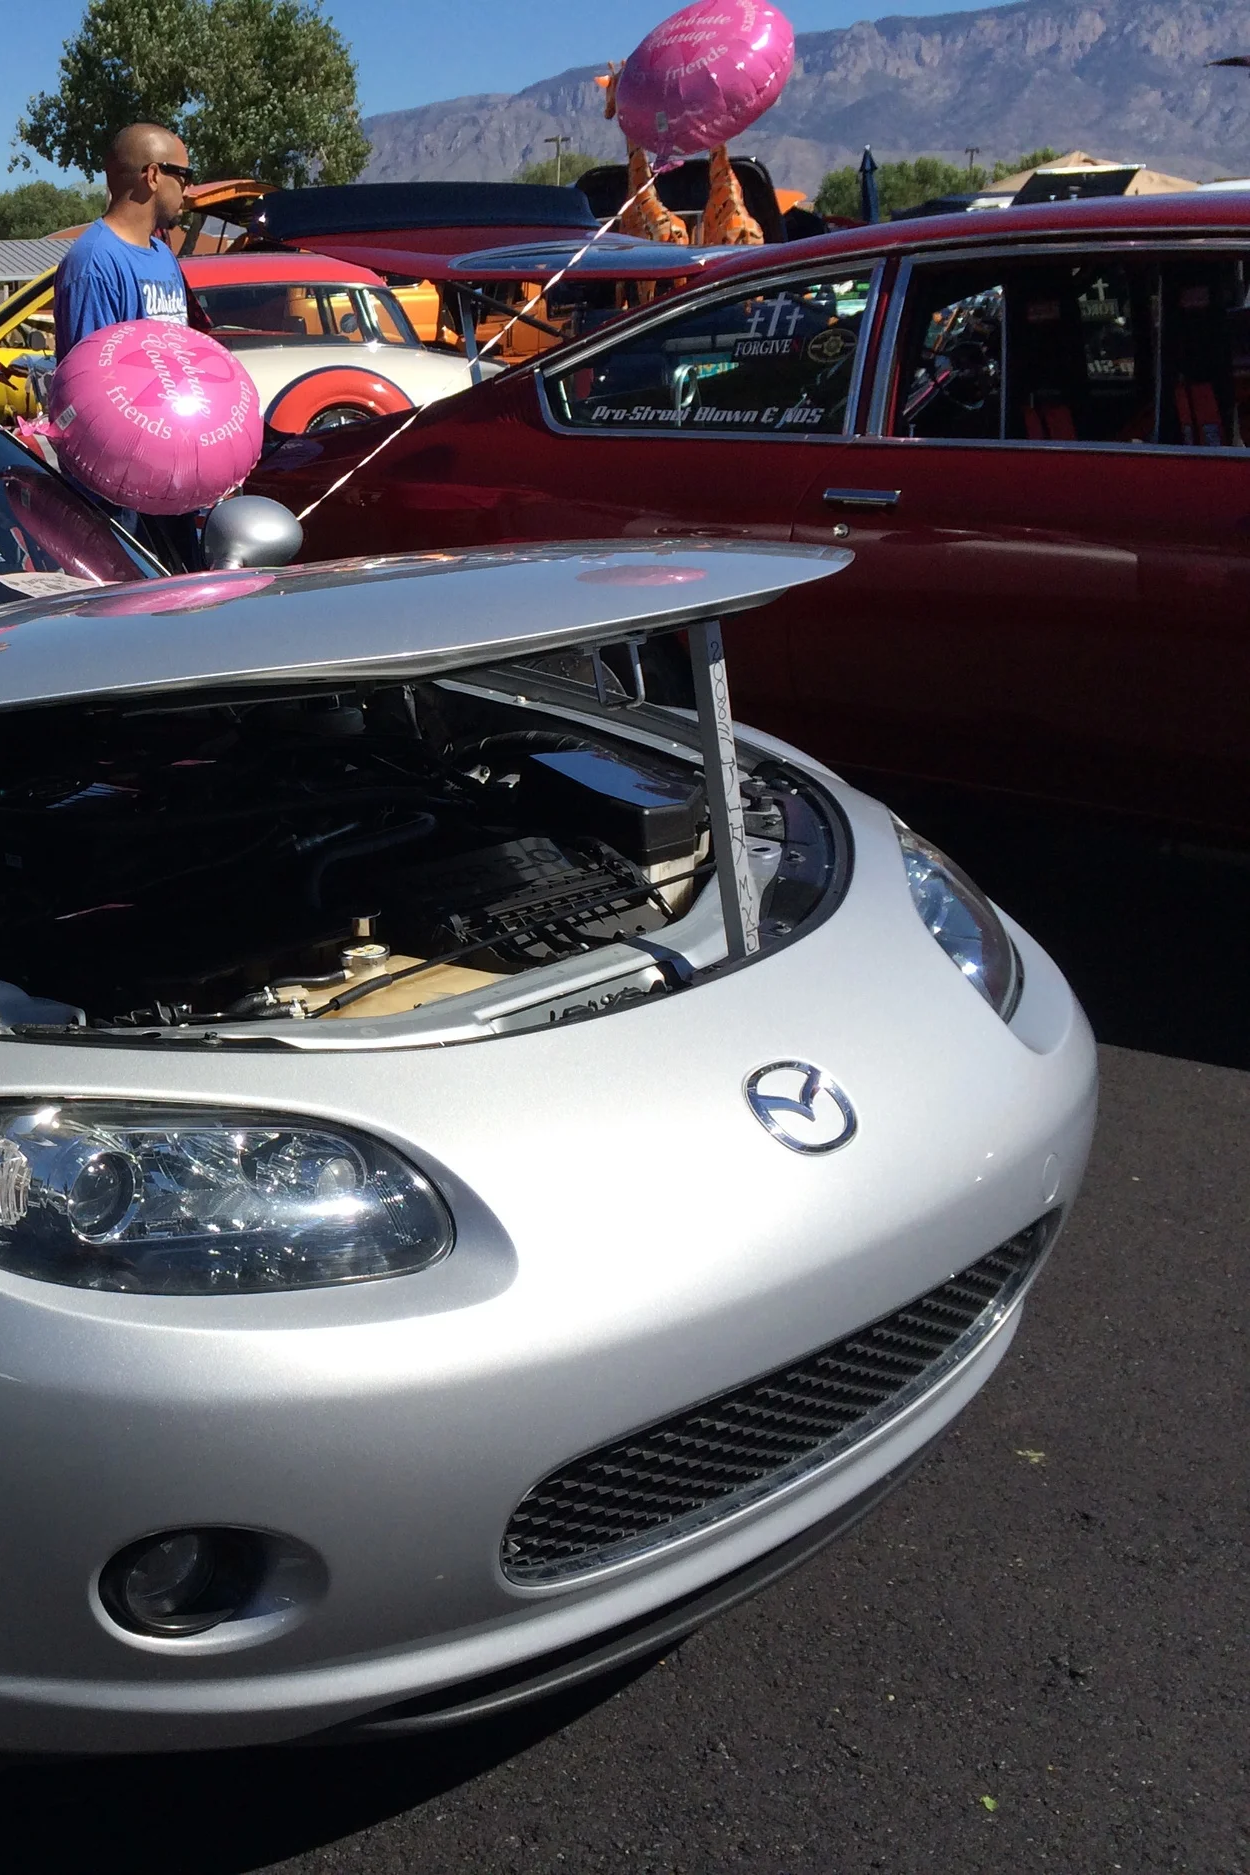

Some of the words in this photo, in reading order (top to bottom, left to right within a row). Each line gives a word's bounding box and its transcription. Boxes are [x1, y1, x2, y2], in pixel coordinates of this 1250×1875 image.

[664, 44, 729, 82] friends
[98, 325, 136, 367] sisters
[140, 333, 182, 408] Courag
[106, 385, 172, 440] friends
[200, 381, 254, 447] daughters
[693, 406, 759, 422] Blown
